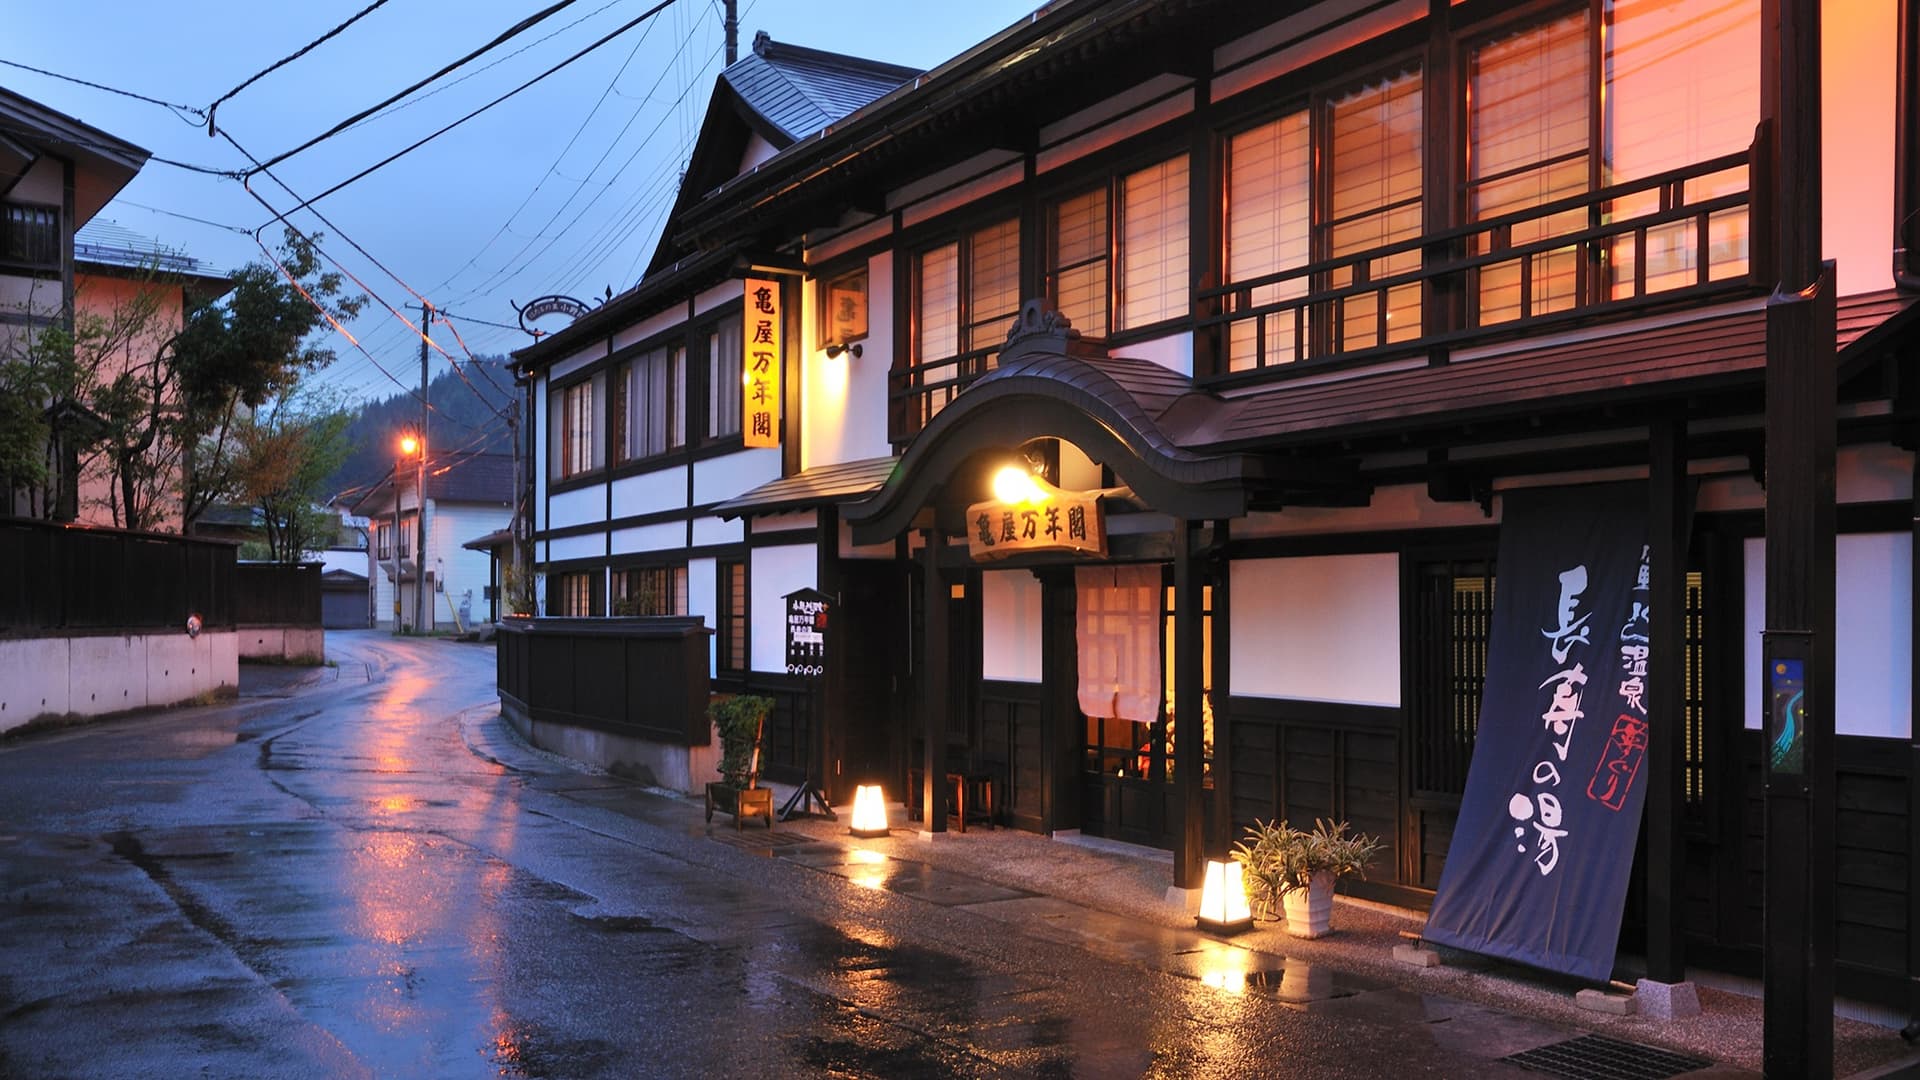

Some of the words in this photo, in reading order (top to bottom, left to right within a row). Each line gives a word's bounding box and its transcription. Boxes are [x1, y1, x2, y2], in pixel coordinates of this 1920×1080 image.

[752, 286, 776, 438] 亀屋万年閣
[975, 505, 1087, 547] 亀屋万年閣
[1508, 564, 1593, 876] 長寿の湯
